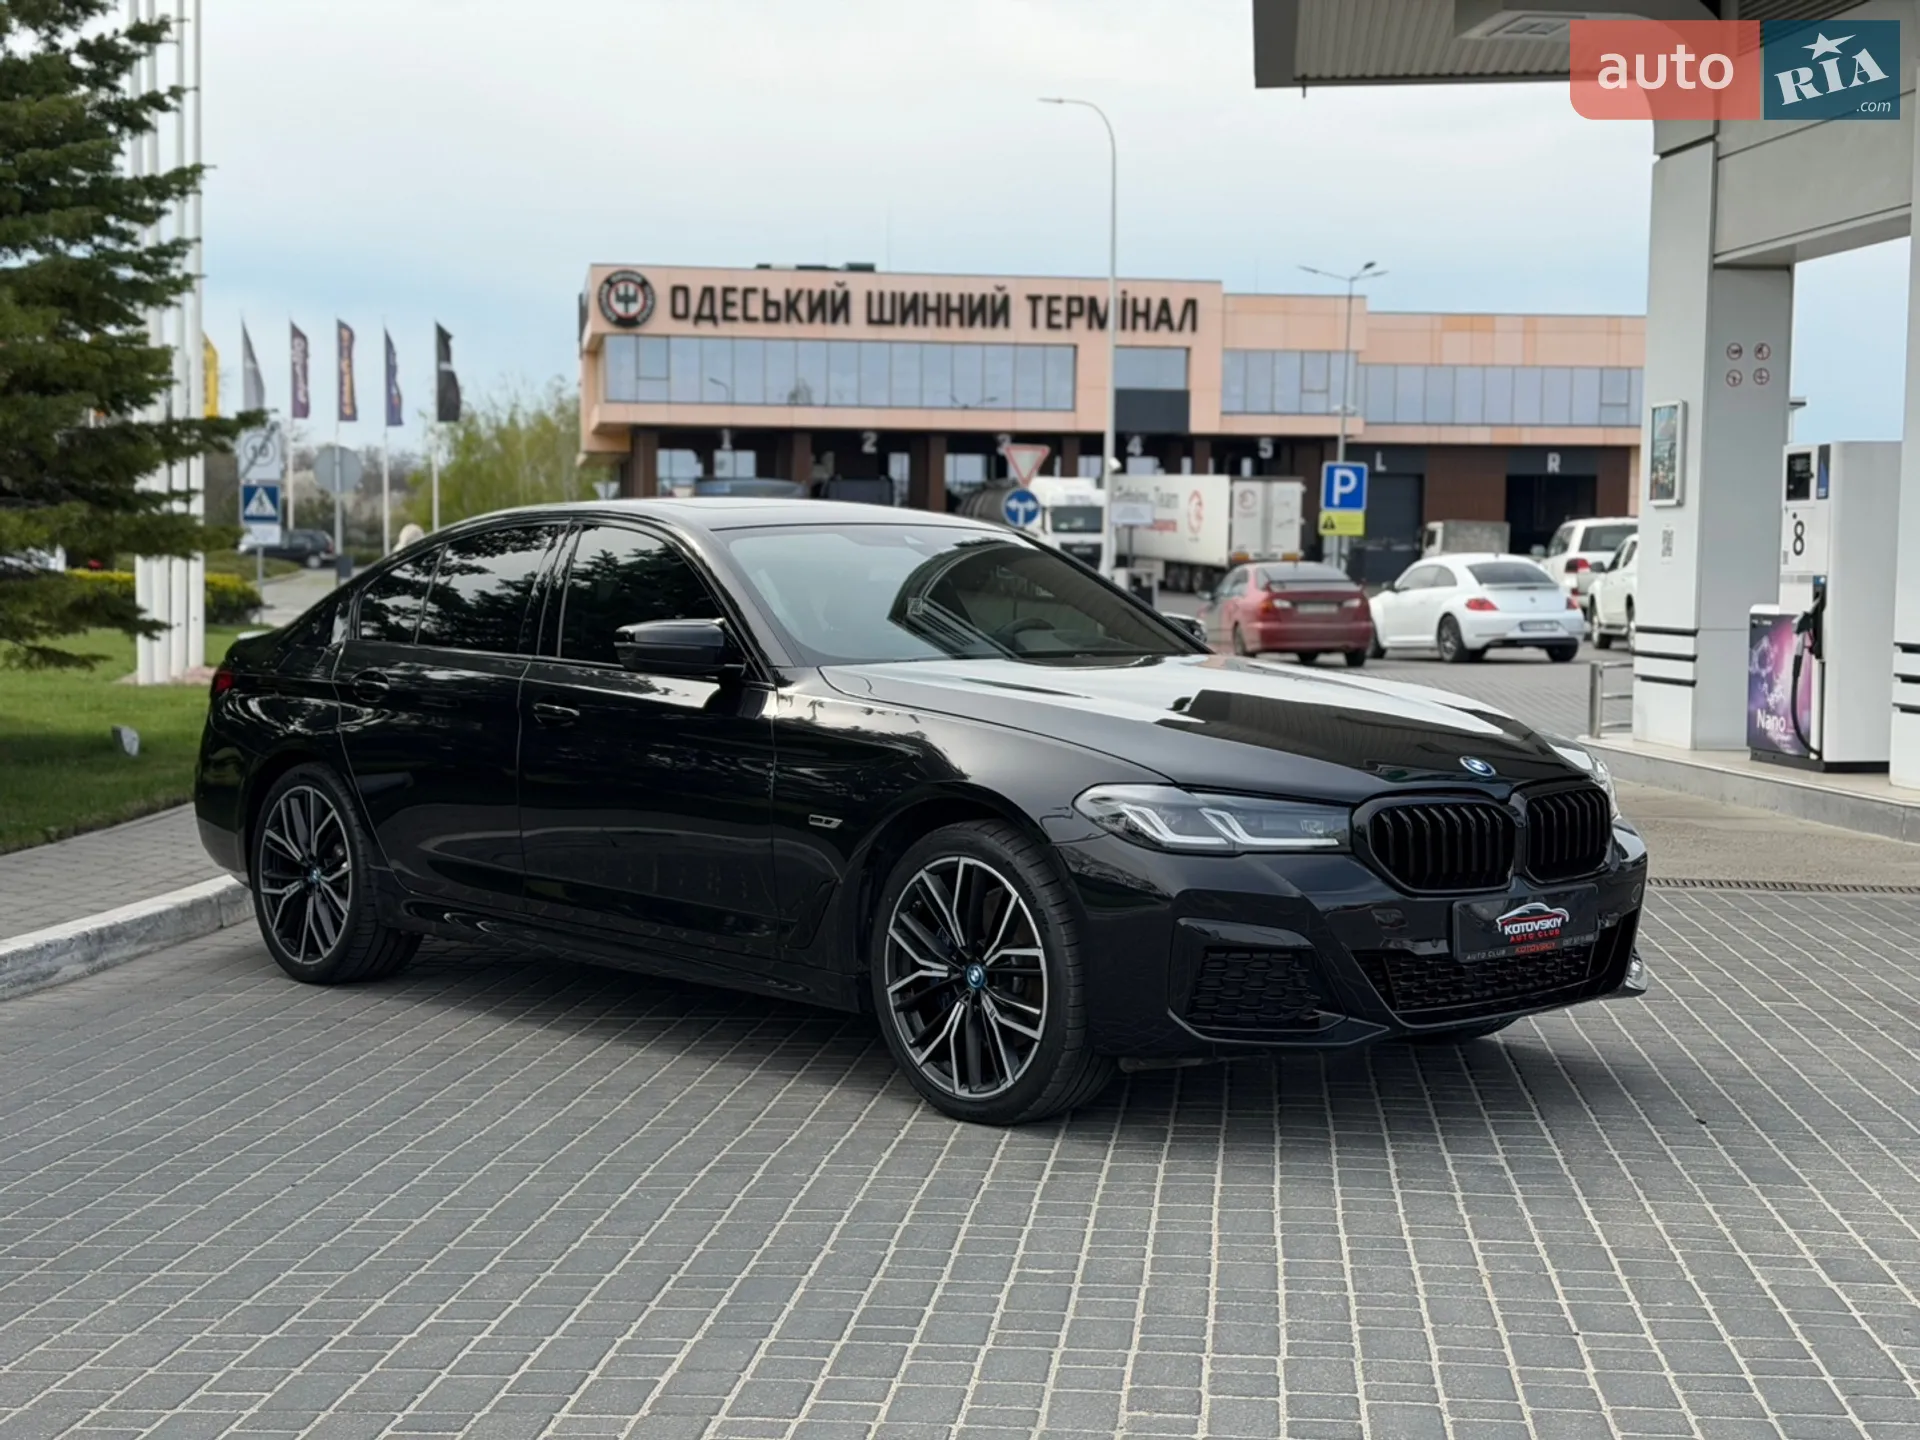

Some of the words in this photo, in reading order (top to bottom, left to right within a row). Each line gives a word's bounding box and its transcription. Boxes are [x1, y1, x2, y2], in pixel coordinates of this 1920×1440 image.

[670, 281, 850, 327] ОДЕСЬКИЙ
[866, 285, 1011, 329] ШИННИЙ
[1026, 290, 1198, 333] ТЕРМІНАЛ
[721, 428, 733, 450] 1
[862, 431, 878, 454] 2
[1126, 436, 1143, 457] 4
[1258, 438, 1274, 459] 5
[1375, 452, 1387, 472] L
[1547, 452, 1561, 474] R
[1332, 468, 1358, 507] P
[1793, 520, 1805, 556] 8
[1756, 708, 1786, 734] Nano
[1504, 917, 1563, 936] KOTOVSKIY
[1509, 932, 1534, 944] AUTO
[1537, 928, 1561, 939] CLUB
